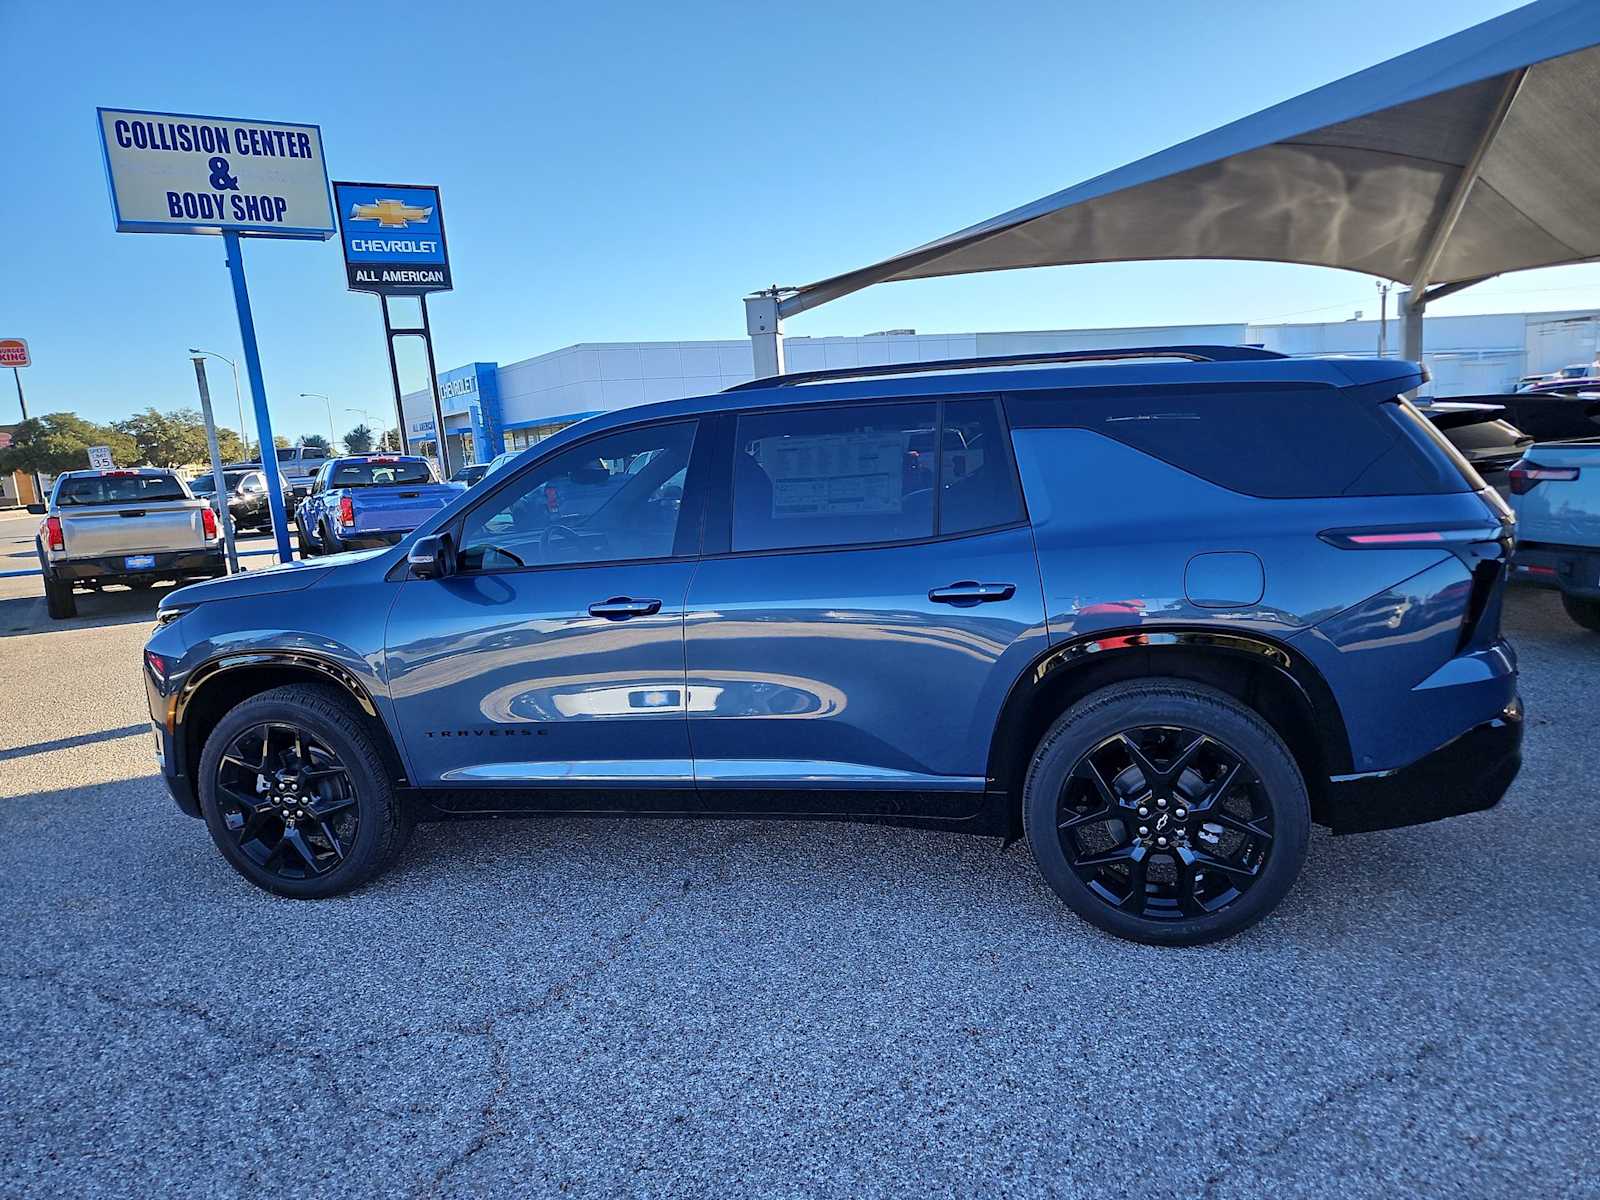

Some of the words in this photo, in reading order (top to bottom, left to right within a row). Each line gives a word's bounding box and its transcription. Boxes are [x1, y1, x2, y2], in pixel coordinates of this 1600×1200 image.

[115, 119, 230, 154] COLLISION
[234, 128, 313, 159] CENTER
[208, 156, 239, 191] &
[166, 191, 226, 219] BODY
[231, 196, 287, 222] SHOP
[351, 239, 438, 253] CHEVROLET
[356, 270, 378, 282] ALL
[382, 271, 444, 282] AMERICAN
[0, 352, 26, 360] KING
[440, 376, 477, 399] CHEVROLET
[95, 458, 110, 468] 35
[425, 729, 549, 738] TRAVERSE
